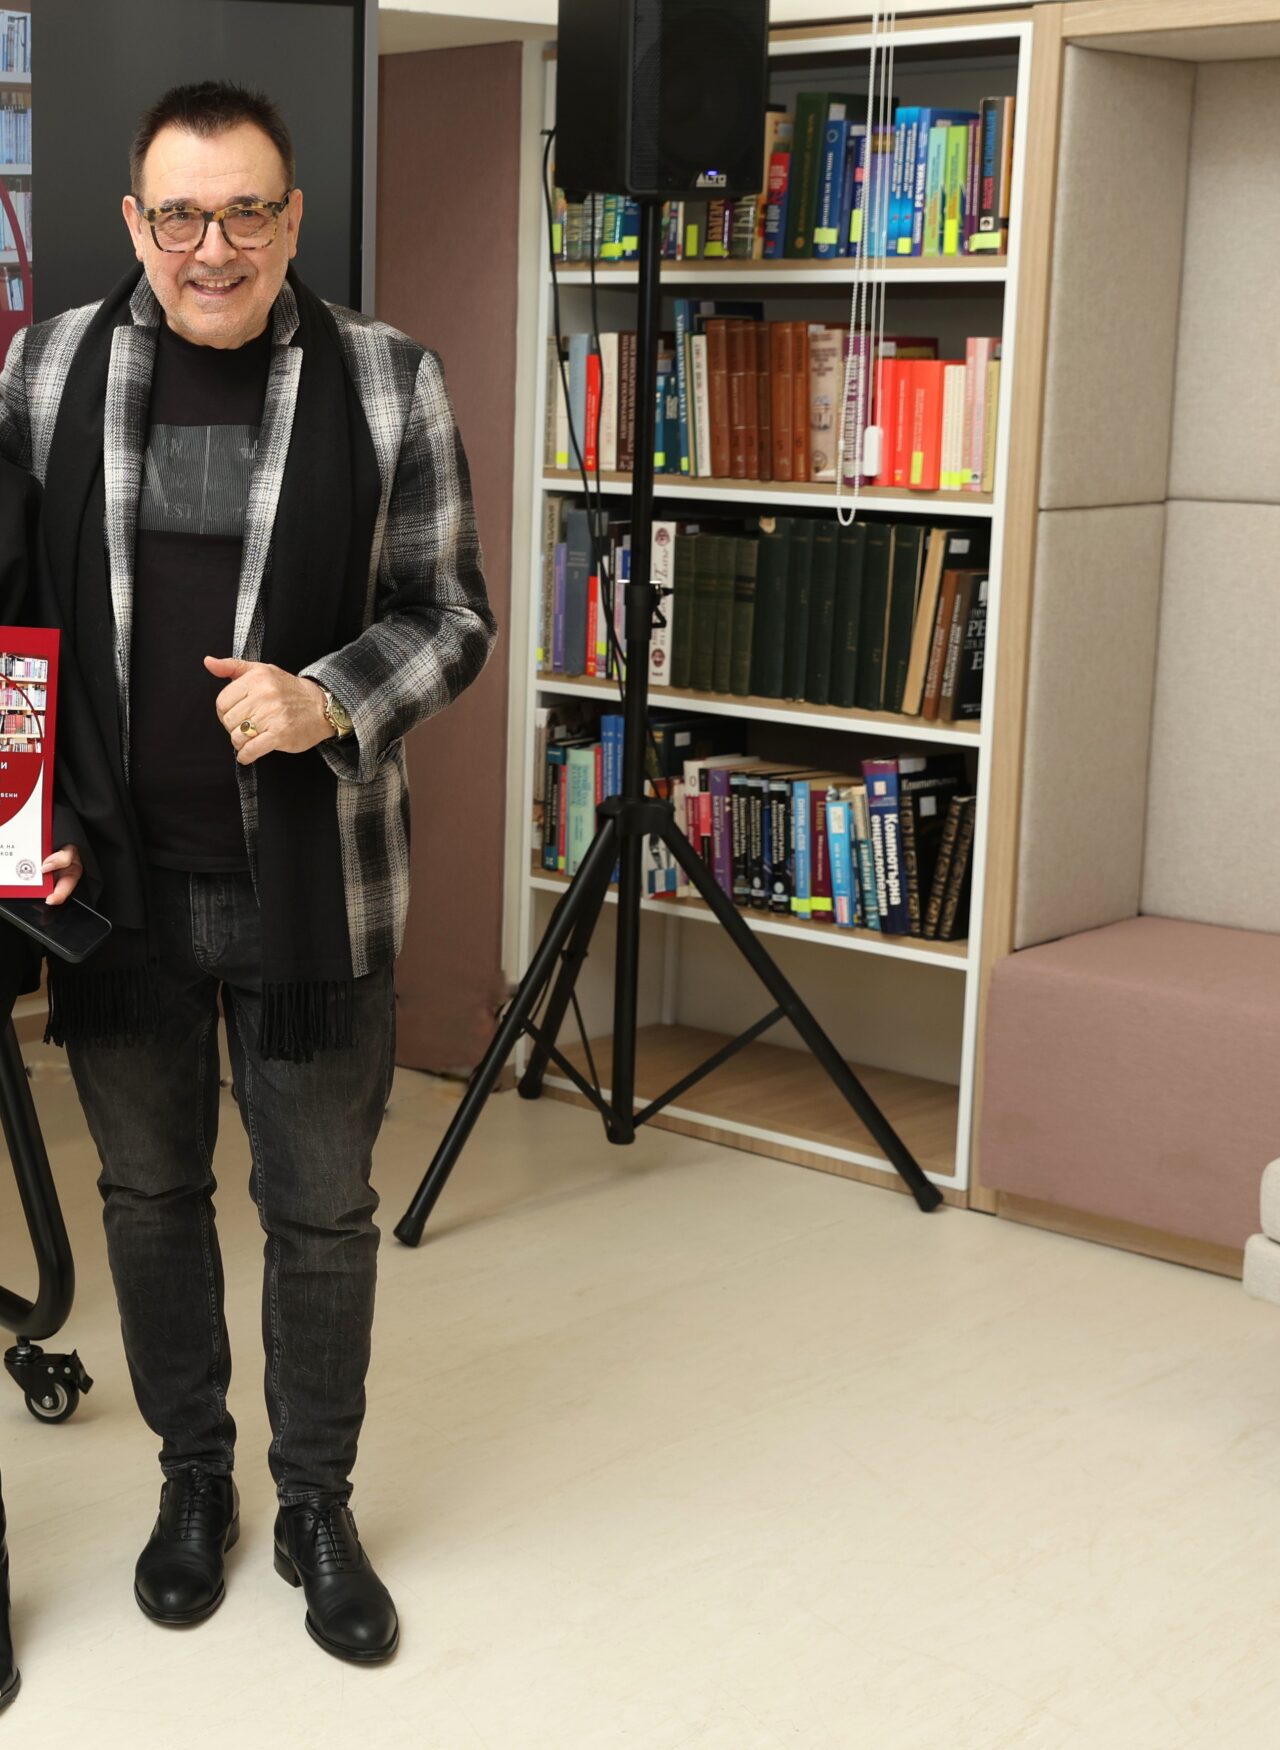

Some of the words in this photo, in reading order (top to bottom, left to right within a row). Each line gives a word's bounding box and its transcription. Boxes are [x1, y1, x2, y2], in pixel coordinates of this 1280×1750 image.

[696, 172, 727, 187] ALTO
[915, 163, 926, 208] РЕЧНИК
[676, 314, 684, 344] МИРА
[677, 346, 685, 388] ЯЗЫКОВ
[679, 391, 687, 424] АТЛАС
[797, 799, 805, 826] DHTML
[816, 801, 825, 831] Linux
[860, 843, 873, 890] Интернет
[871, 814, 889, 916] енциклопедия
[884, 813, 902, 906] Компютърна
